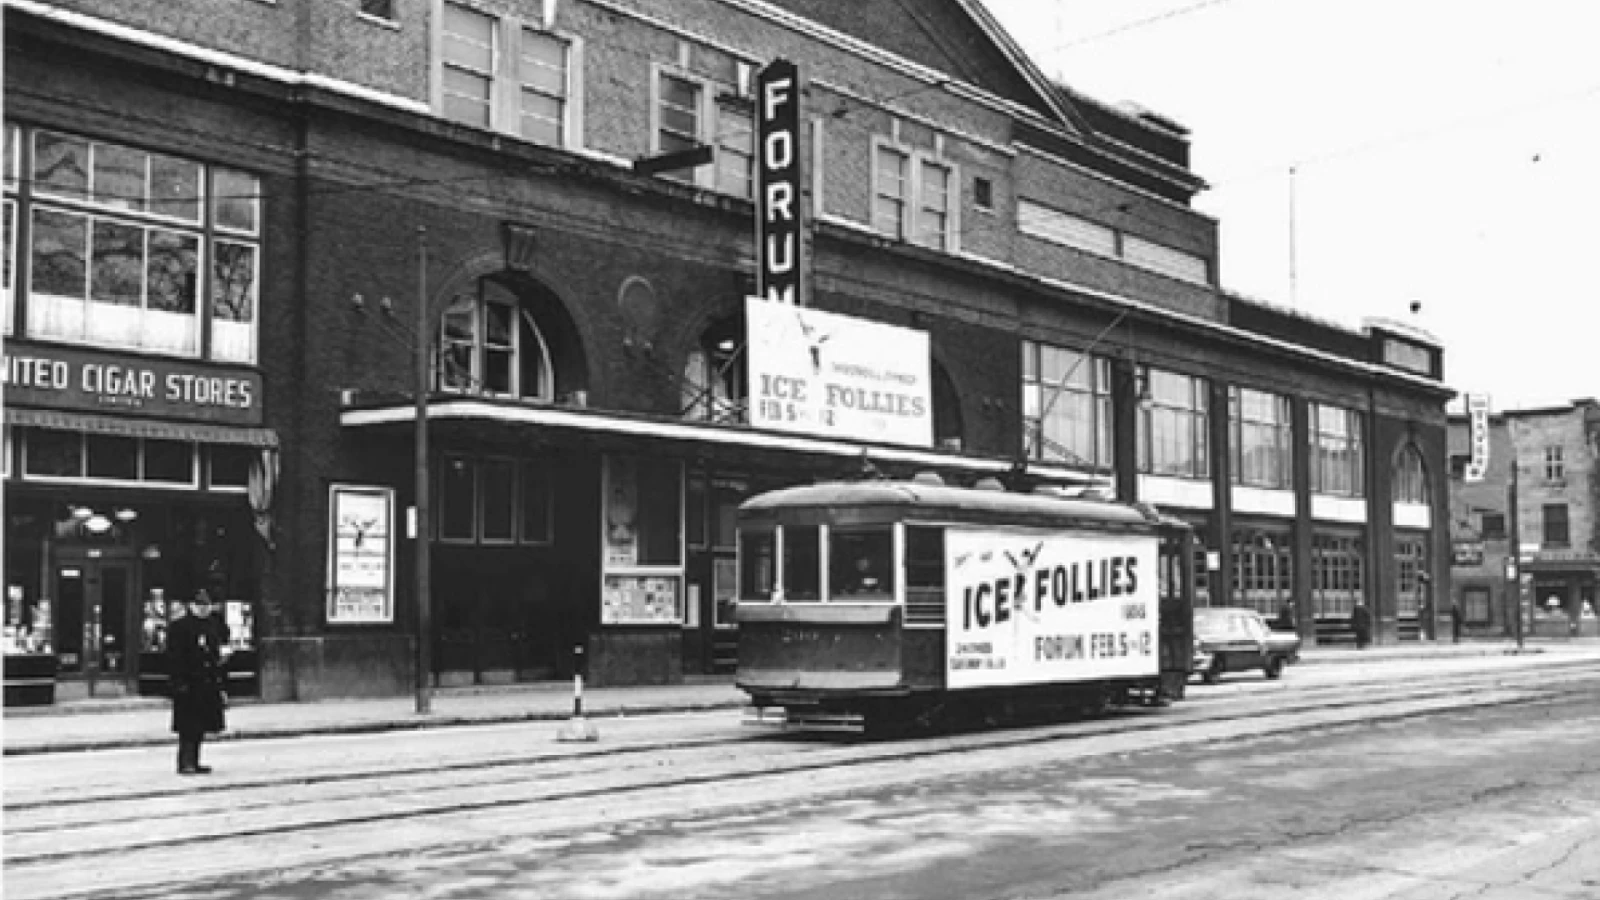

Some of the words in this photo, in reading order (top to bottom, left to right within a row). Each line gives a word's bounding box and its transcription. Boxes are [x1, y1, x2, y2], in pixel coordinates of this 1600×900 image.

[82, 363, 155, 399] CIGAR
[166, 374, 252, 408] STORES
[760, 374, 806, 402] ICE
[825, 383, 926, 417] FOLLIES
[963, 578, 1012, 631] ICE
[1035, 556, 1138, 612] FOLLIES
